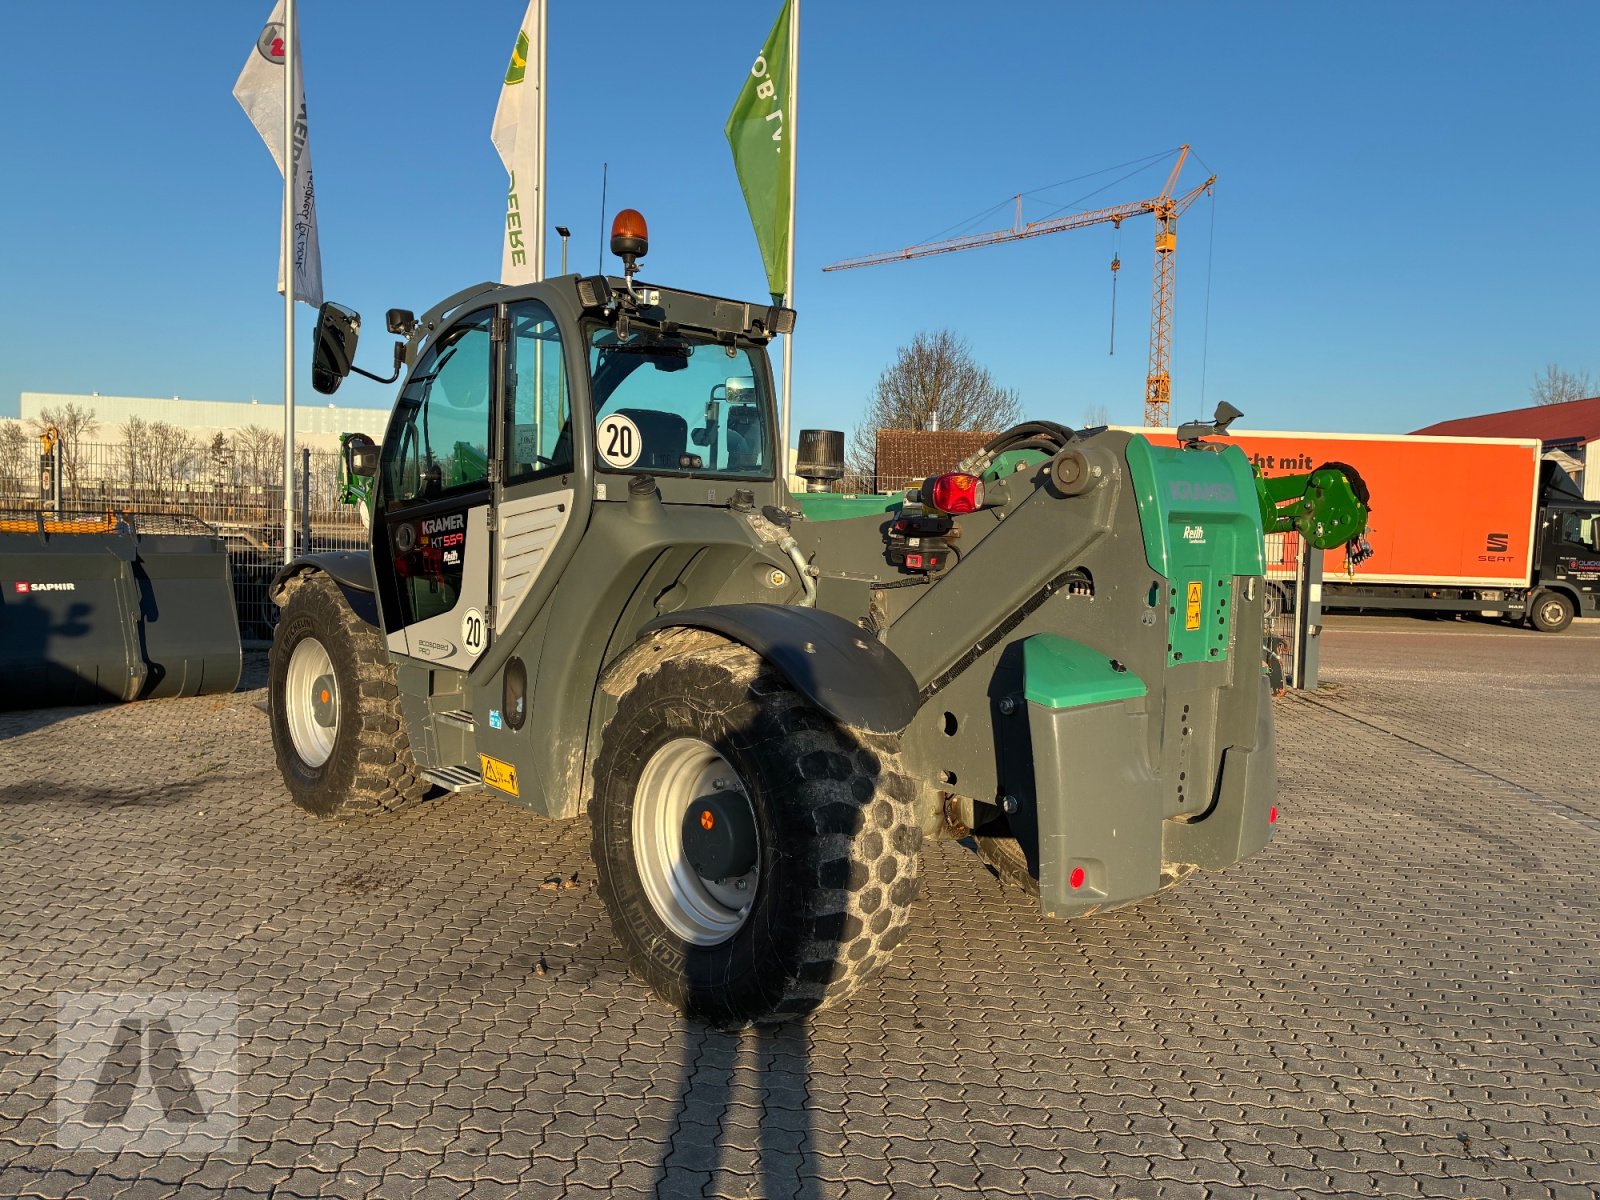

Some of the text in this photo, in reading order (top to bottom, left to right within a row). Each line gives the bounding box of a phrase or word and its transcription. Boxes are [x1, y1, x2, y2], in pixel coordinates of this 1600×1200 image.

[606, 423, 632, 458] 20
[1280, 453, 1313, 470] mit
[421, 514, 464, 535] KRAMER
[30, 583, 75, 591] SAPHIR
[466, 616, 480, 648] 20
[418, 639, 449, 652] ecospeed
[418, 646, 431, 656] PRO
